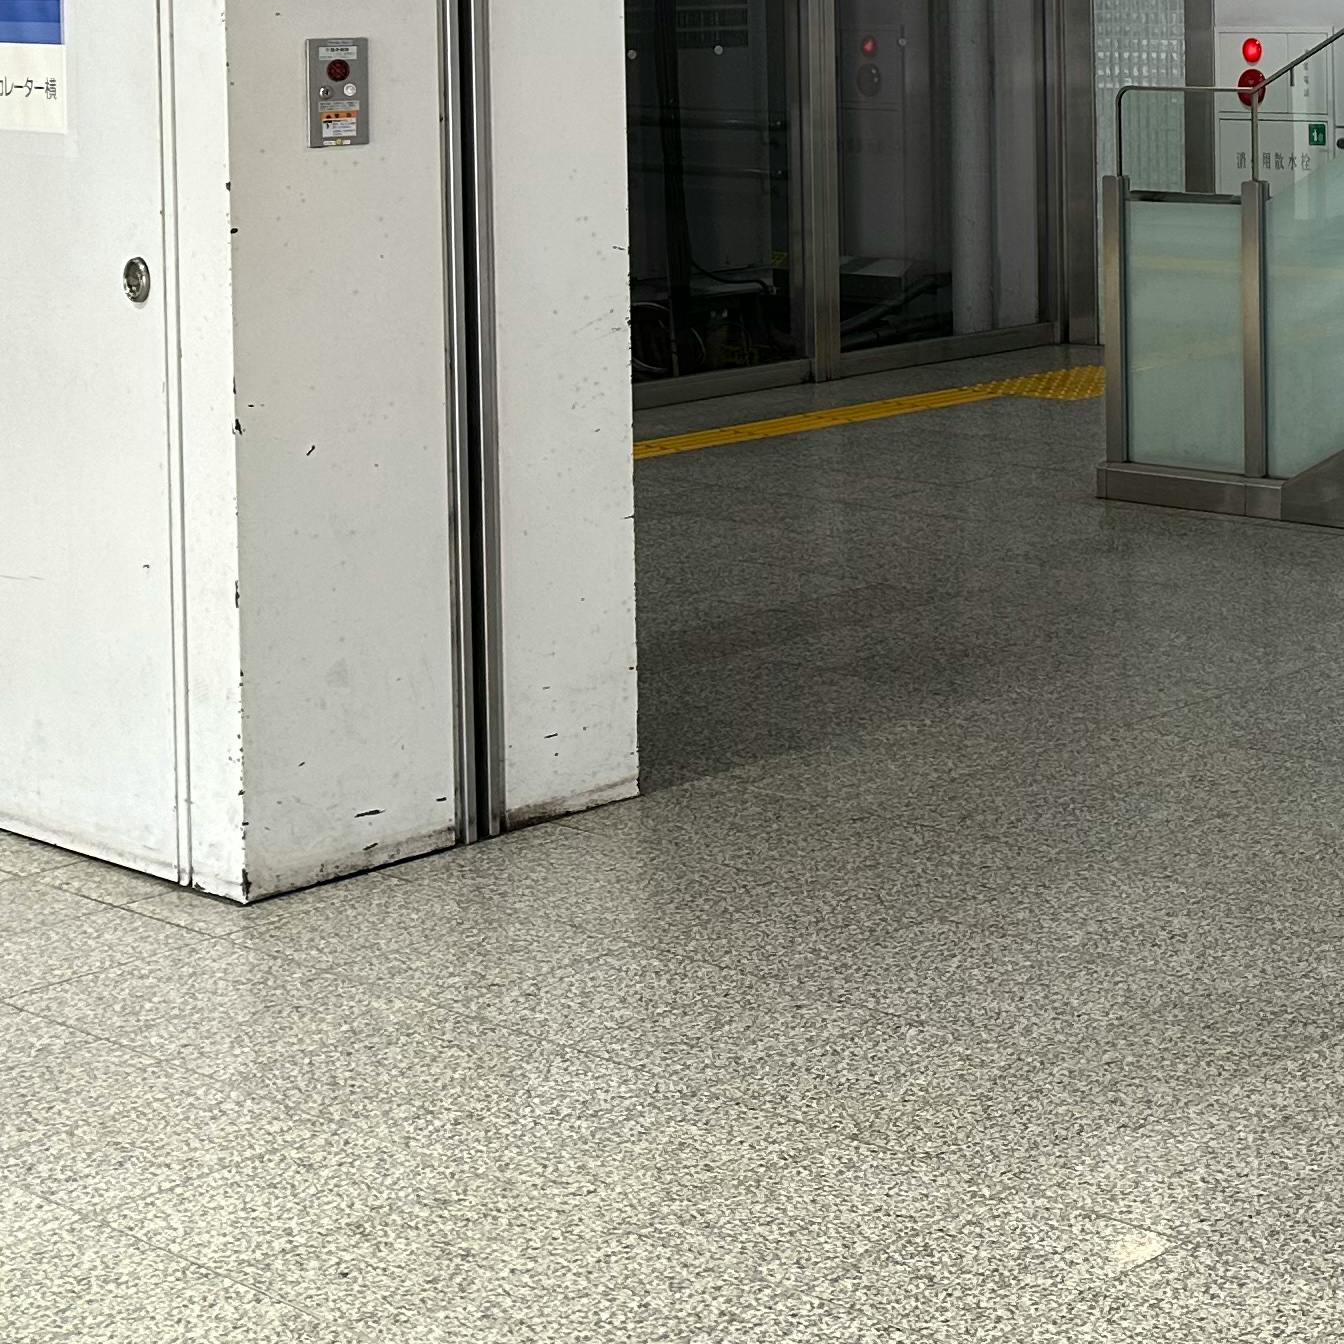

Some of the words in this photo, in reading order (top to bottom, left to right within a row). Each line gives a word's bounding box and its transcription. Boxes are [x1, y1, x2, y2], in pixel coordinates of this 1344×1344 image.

[1236, 151, 1312, 171] 消用散水栓
